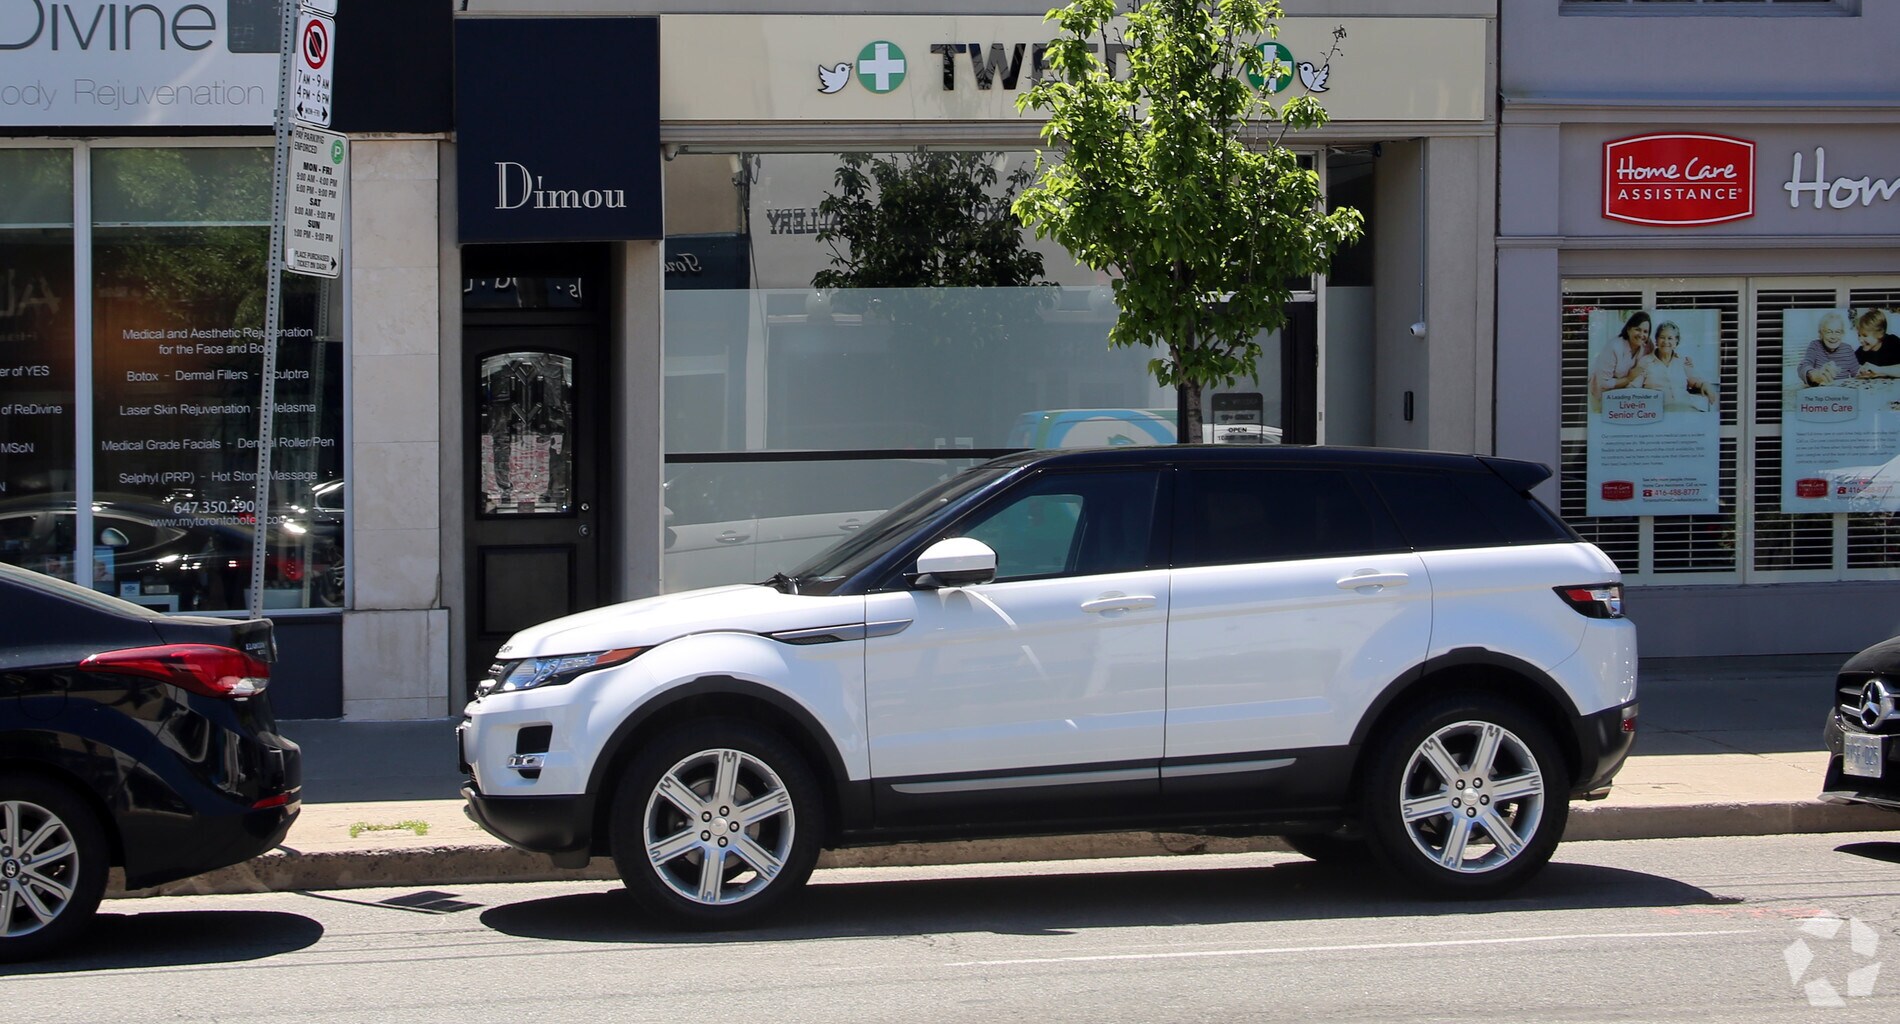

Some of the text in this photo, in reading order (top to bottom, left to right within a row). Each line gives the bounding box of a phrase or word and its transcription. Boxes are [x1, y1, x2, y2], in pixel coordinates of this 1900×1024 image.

[74, 78, 264, 111] Rejuvenation
[303, 161, 333, 175] MON FRI
[1616, 155, 1737, 180] Home Care
[1783, 146, 1900, 209] Hom
[494, 161, 627, 210] Dimou
[309, 197, 321, 207] SAT
[307, 219, 320, 229] SUN
[122, 328, 164, 340] Medical
[166, 328, 188, 339] and
[190, 327, 241, 339] Aesthetic
[159, 344, 174, 355] for
[176, 344, 194, 355] the
[196, 343, 224, 354] Face
[226, 343, 247, 354] and
[12, 366, 23, 376] of
[25, 365, 50, 376] YES
[127, 369, 309, 382] Botox Dermal Fillers culptra
[1, 403, 62, 415] of ReDivine
[119, 405, 151, 416] Laser
[153, 404, 178, 415] Skin
[180, 403, 250, 417] Rejuvenation
[1619, 401, 1646, 410] Live-in
[1800, 402, 1853, 413] Home Care
[1608, 410, 1656, 419] Senior Care
[1, 442, 34, 453] MScN
[101, 439, 144, 451] Medical
[146, 439, 181, 451] Grade
[183, 438, 221, 450] Facials
[279, 436, 335, 449] Roller/Pen
[119, 469, 318, 485] Selphyl (PRP) Hot Ston Massage
[173, 500, 257, 515] 647.350.290
